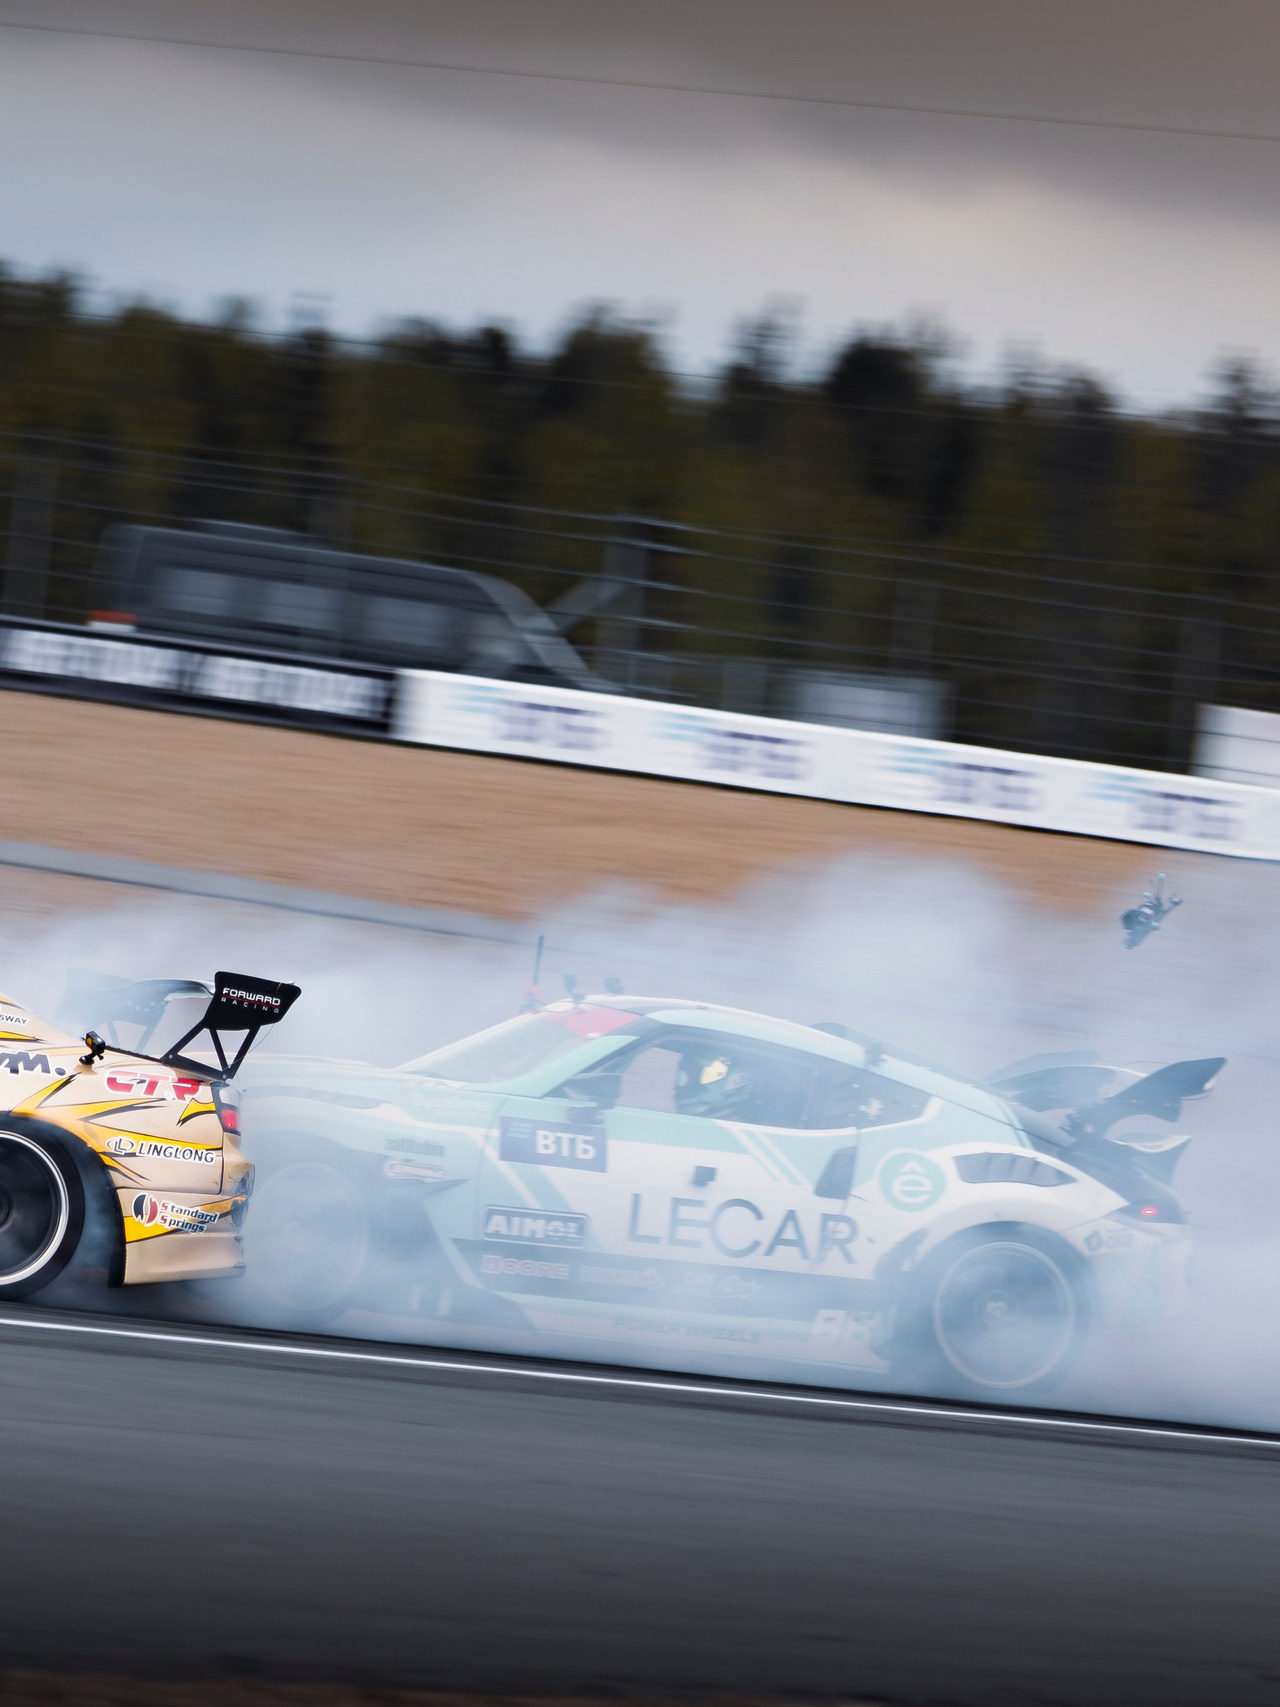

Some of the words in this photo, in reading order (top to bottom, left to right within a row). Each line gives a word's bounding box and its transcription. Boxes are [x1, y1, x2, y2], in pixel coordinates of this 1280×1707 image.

[221, 997, 279, 1013] RACING
[223, 987, 281, 1006] FORWARD
[107, 1071, 200, 1101] CTR
[138, 1142, 214, 1163] LINGLONG
[535, 1129, 596, 1160] ВТБ
[160, 1202, 218, 1223] Standard
[160, 1215, 205, 1234] Springs
[485, 1214, 582, 1240] AIMOL
[627, 1193, 859, 1264] LECAR
